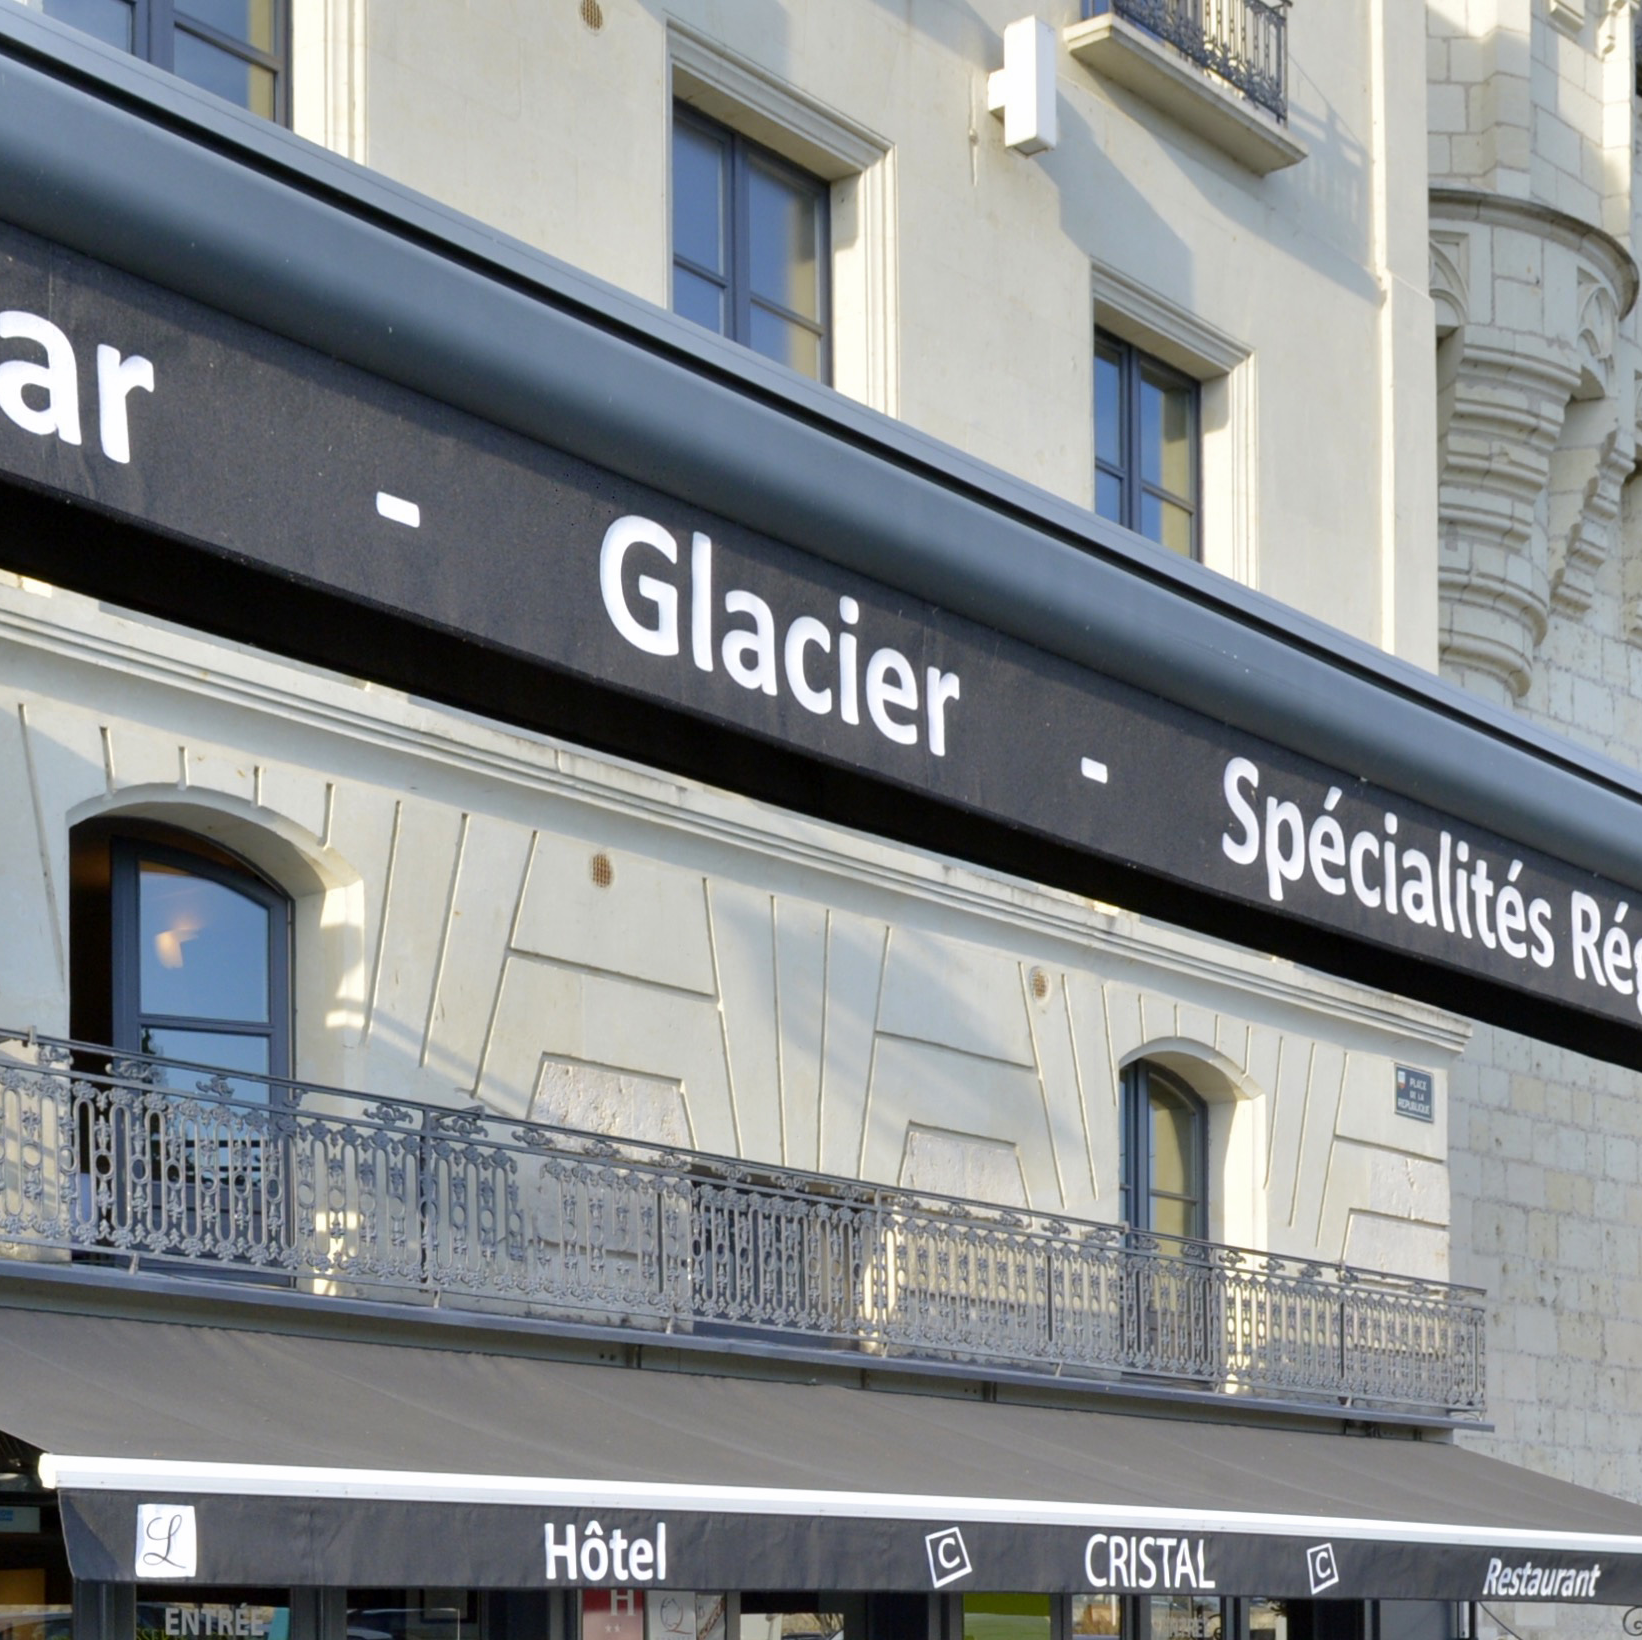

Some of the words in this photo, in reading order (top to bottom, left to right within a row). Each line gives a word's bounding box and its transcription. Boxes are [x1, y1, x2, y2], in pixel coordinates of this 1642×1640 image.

[599, 514, 960, 758] Glacier
[1221, 756, 1554, 969] Spécialités
[1409, 1077, 1428, 1092] PLACE
[544, 1522, 667, 1582] Hôtel
[1084, 1533, 1216, 1590] CRISTAL
[1483, 1557, 1600, 1599] Restaurant
[165, 1603, 265, 1637] ENTRÉE
[610, 1590, 636, 1617] H
